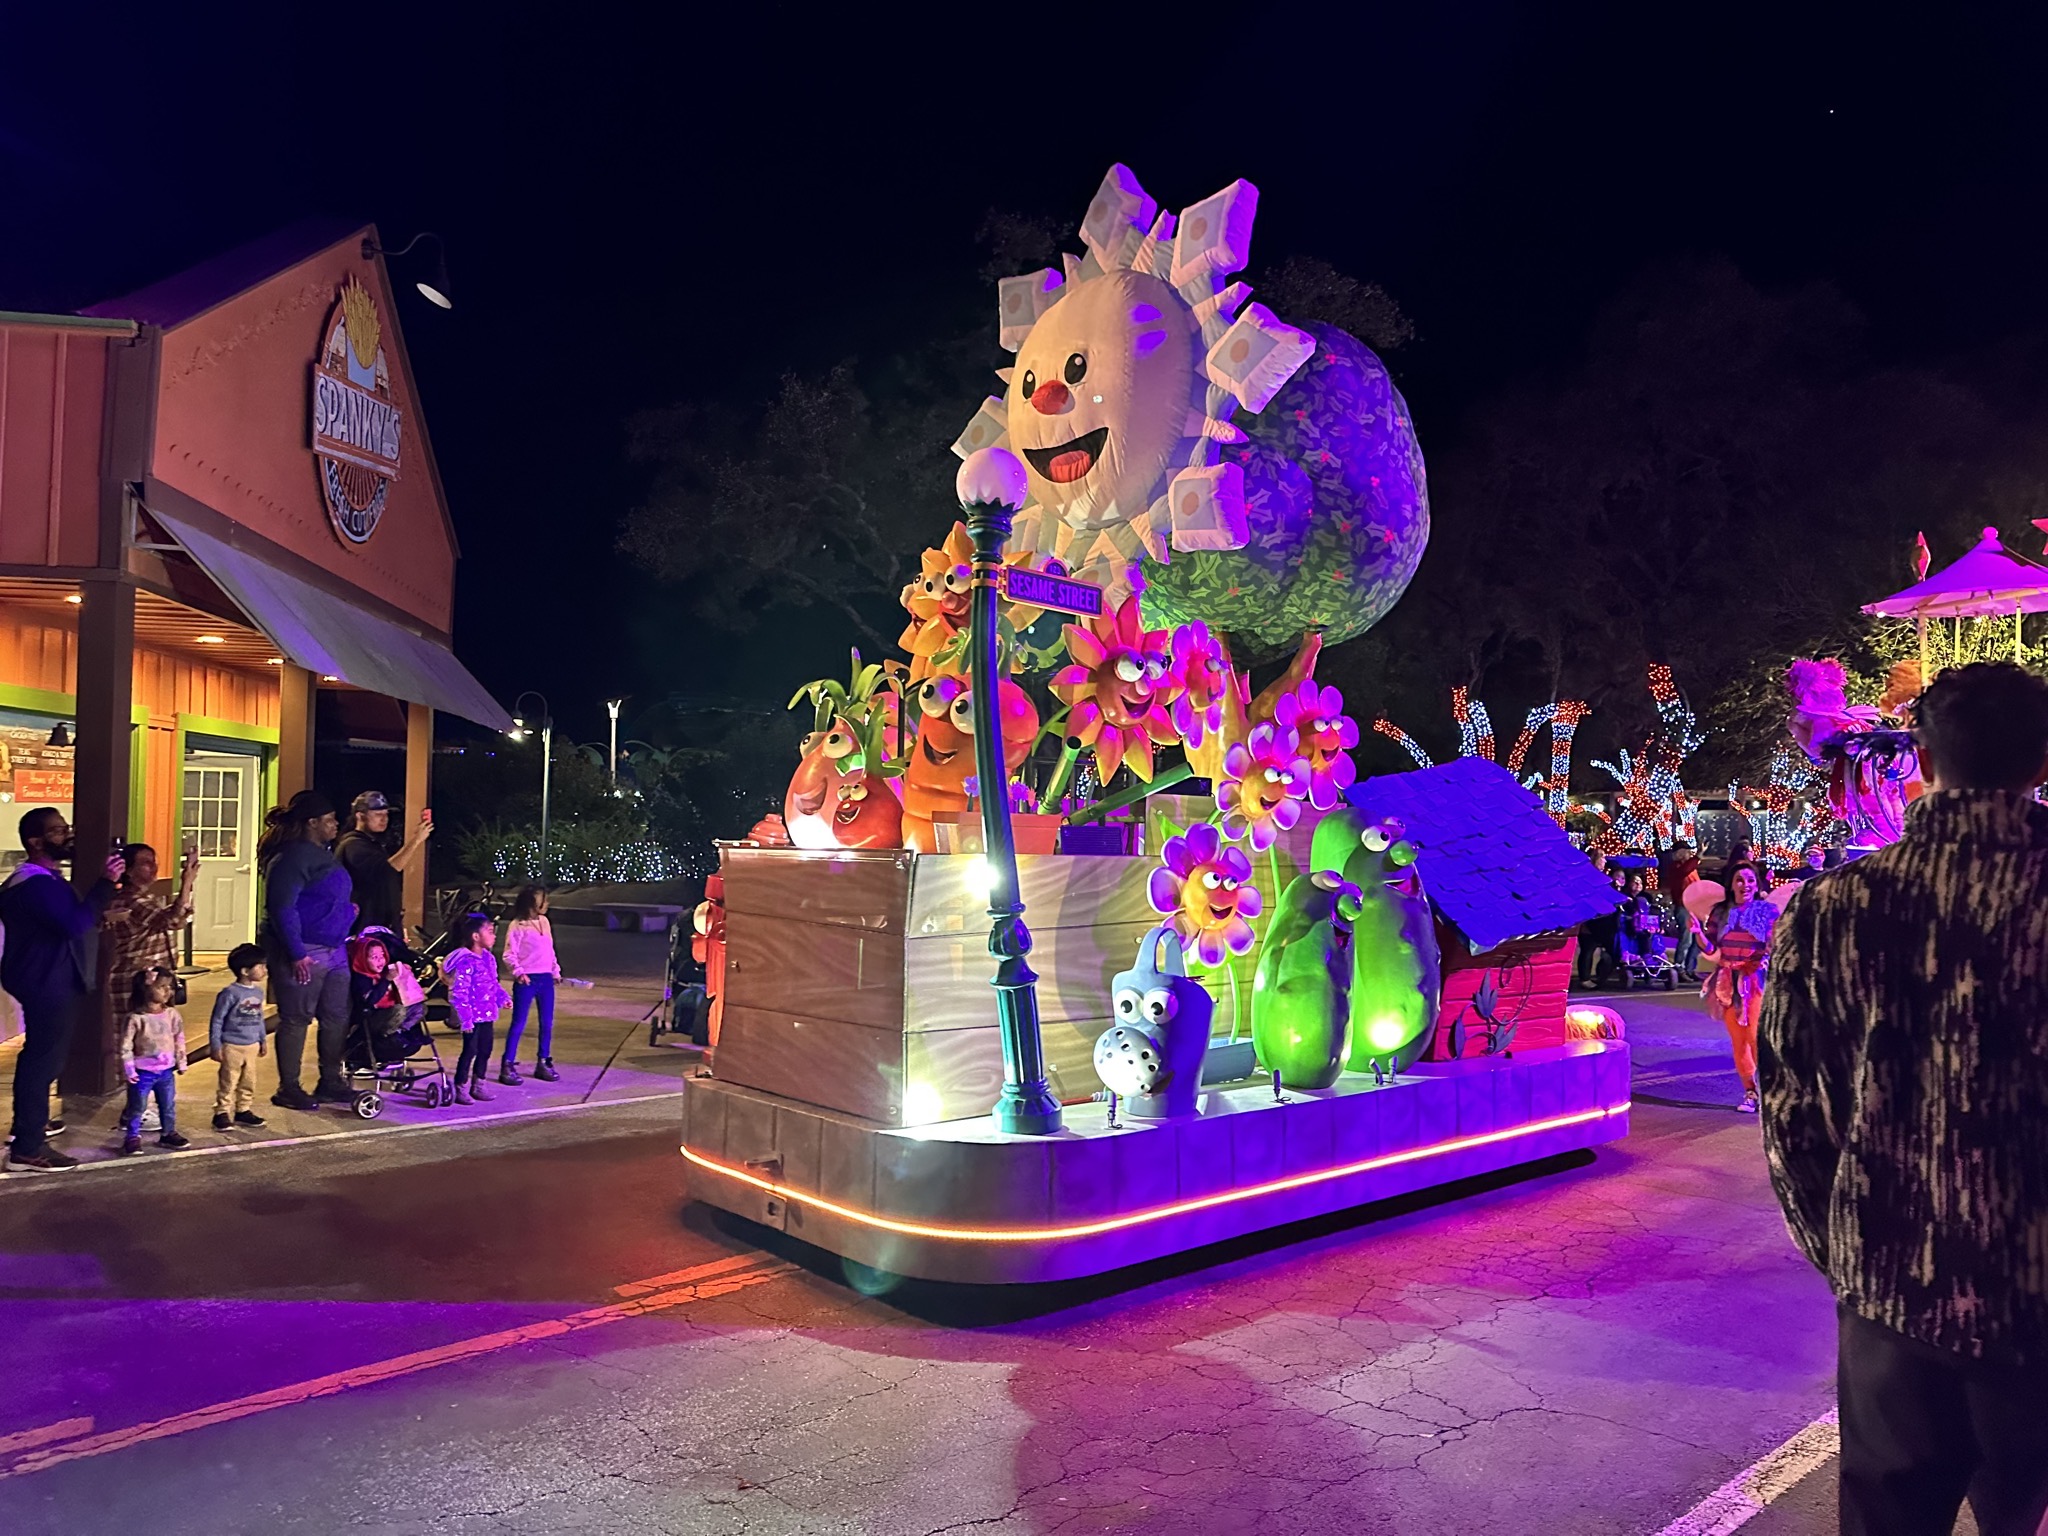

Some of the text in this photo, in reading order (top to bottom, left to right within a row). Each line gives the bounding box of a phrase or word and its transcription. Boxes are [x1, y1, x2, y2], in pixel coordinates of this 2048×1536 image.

[316, 376, 400, 461] SPANKY'S
[1010, 572, 1098, 611] SESAME STREET
